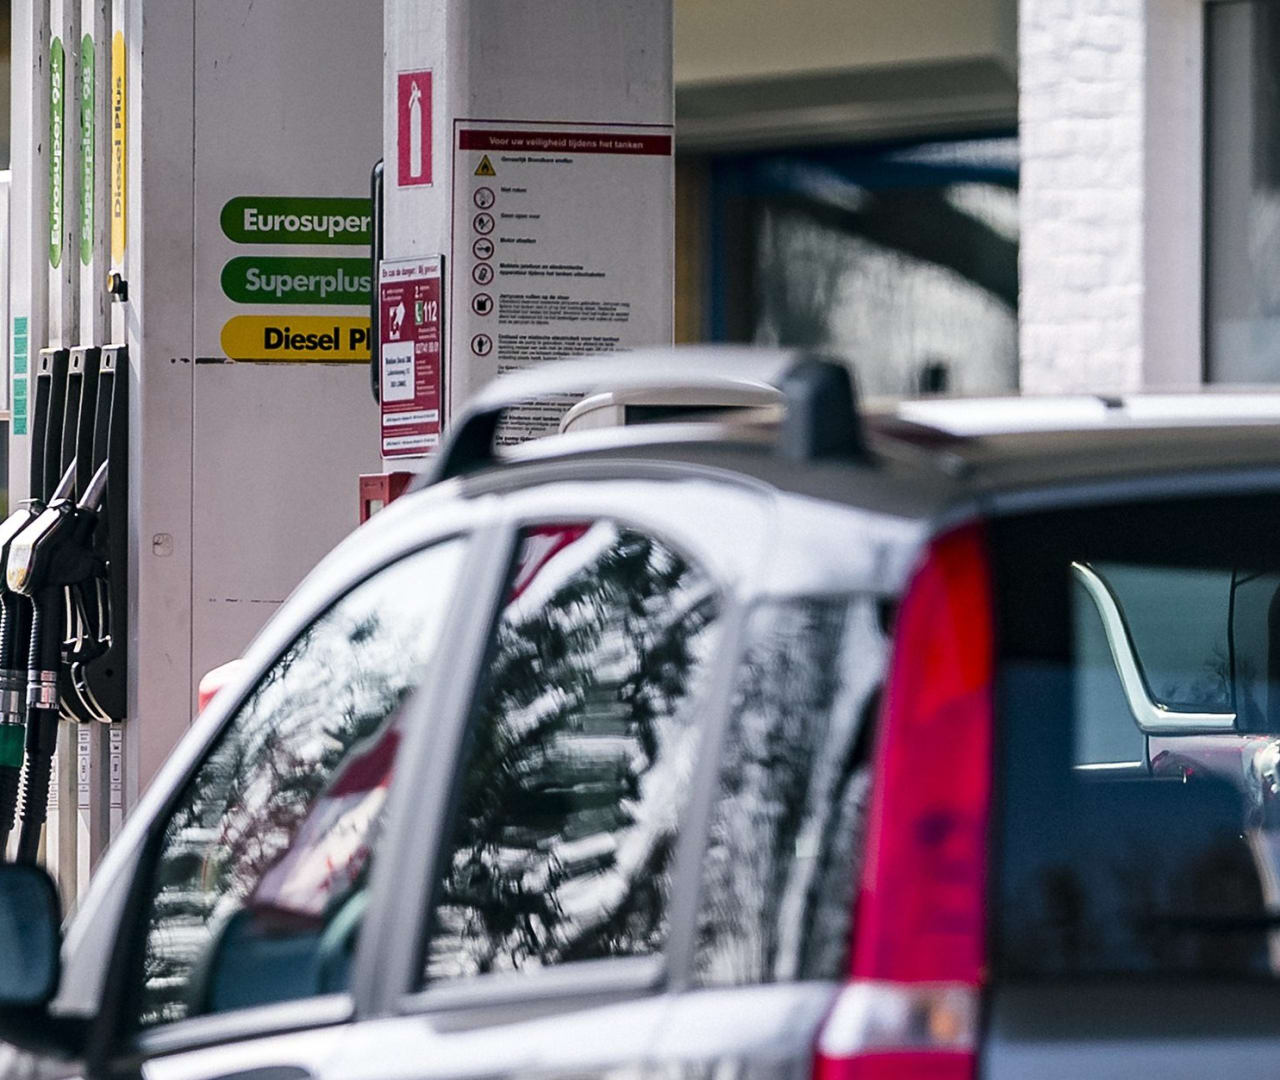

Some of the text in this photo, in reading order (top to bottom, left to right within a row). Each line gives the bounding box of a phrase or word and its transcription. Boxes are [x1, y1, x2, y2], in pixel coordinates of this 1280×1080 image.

[114, 76, 122, 129] Plus
[51, 57, 62, 245] Eurosuper 95+
[489, 136, 510, 146] Voor
[526, 137, 567, 149] veiligheid
[568, 139, 597, 150] tijdens
[599, 140, 613, 149] het
[614, 140, 644, 149] tanken
[82, 108, 92, 241] Superplus
[243, 207, 371, 239] Eurosuper
[245, 267, 371, 298] Superplus
[423, 300, 438, 322] 112
[264, 326, 340, 350] Diesel
